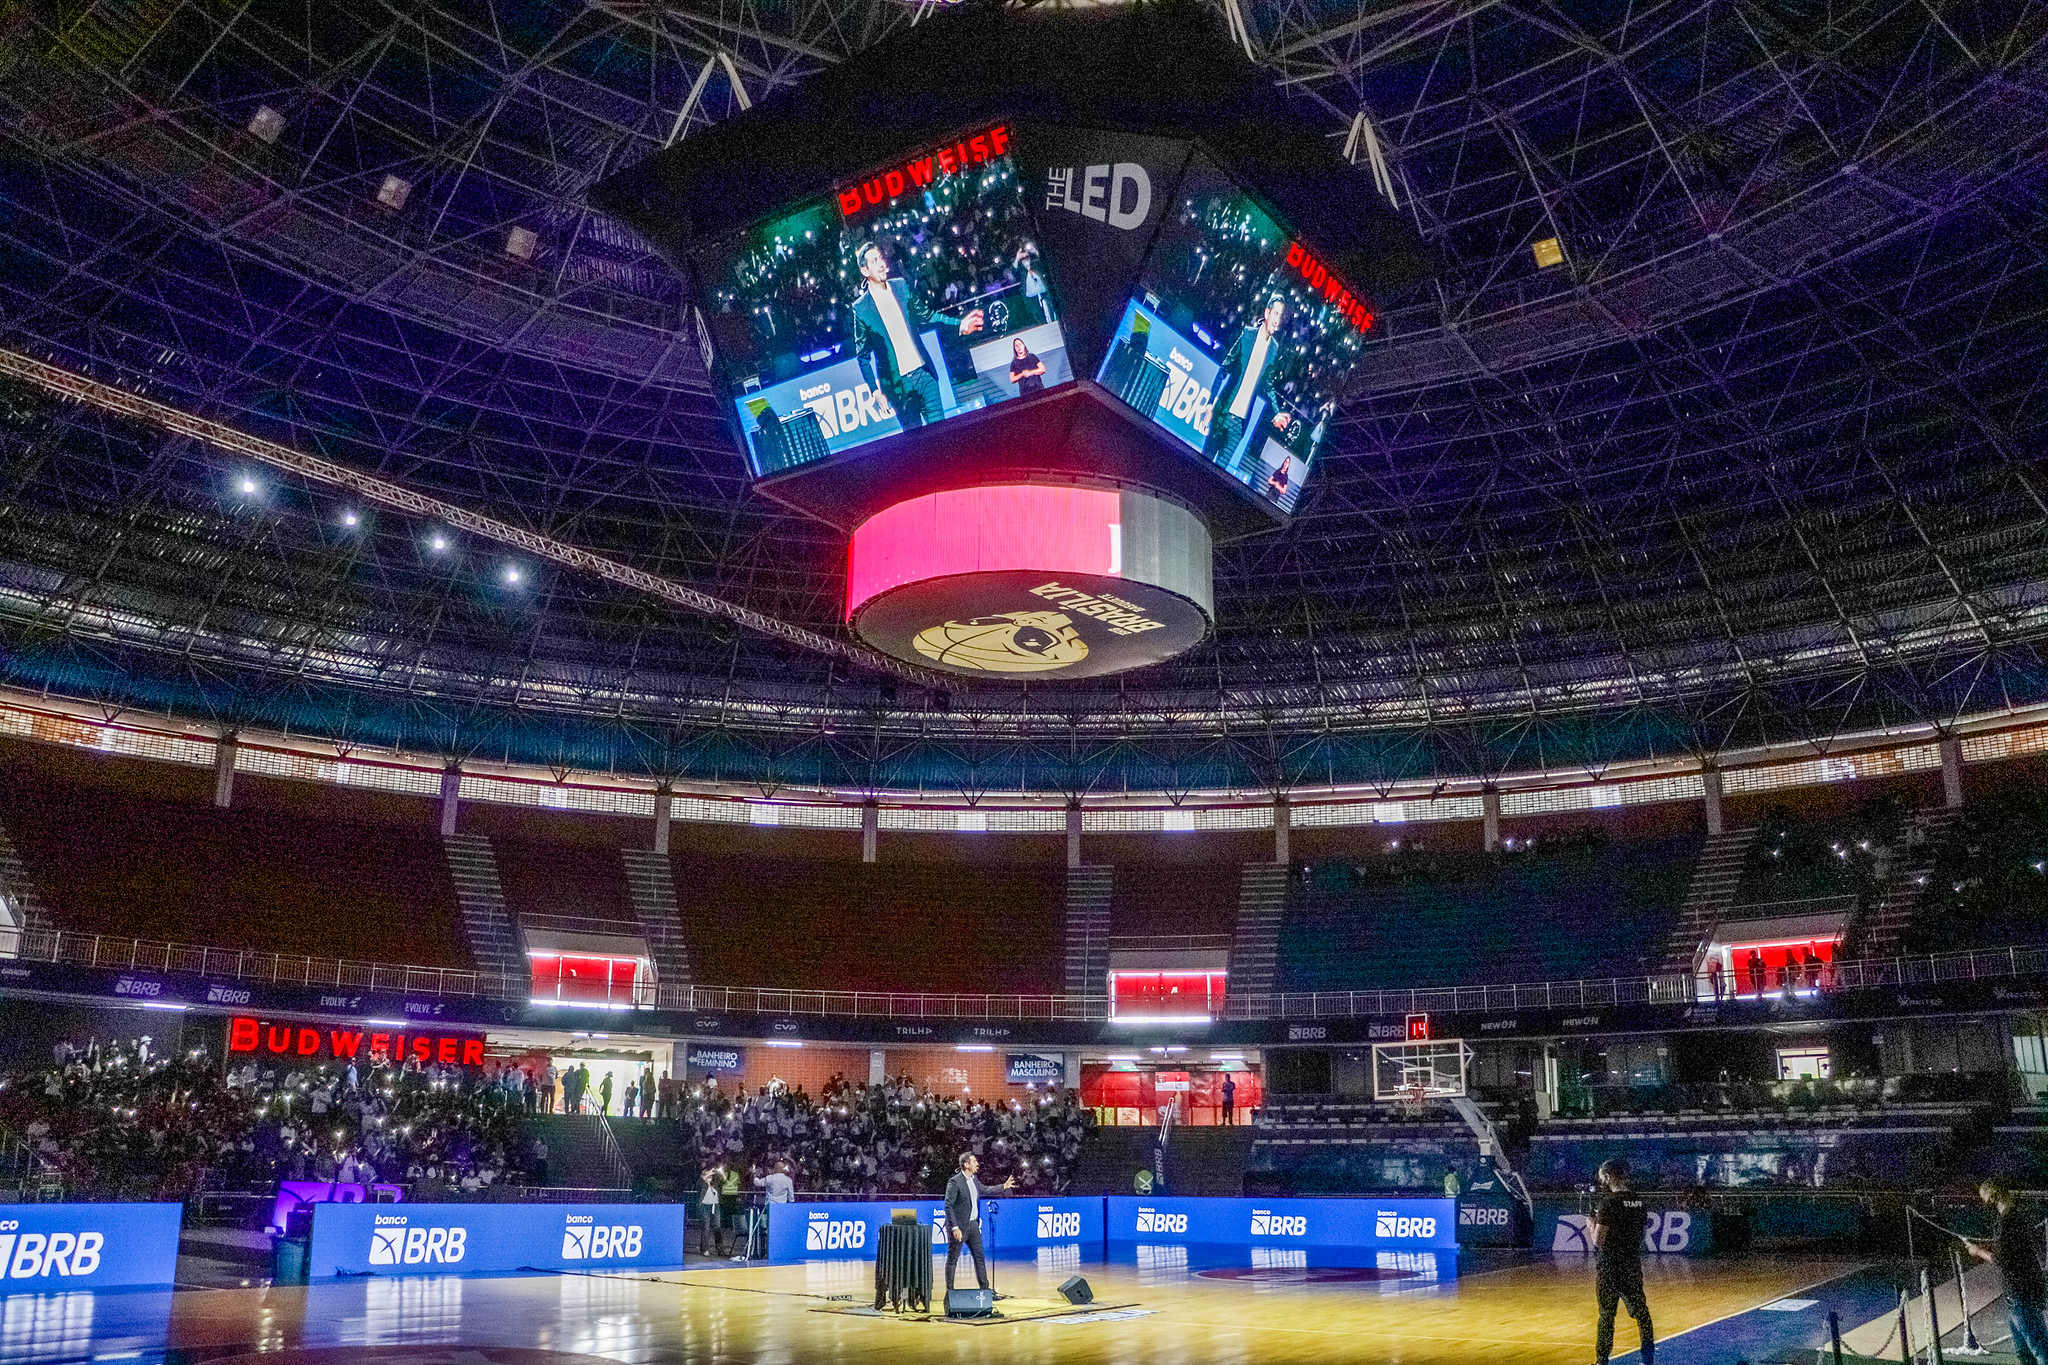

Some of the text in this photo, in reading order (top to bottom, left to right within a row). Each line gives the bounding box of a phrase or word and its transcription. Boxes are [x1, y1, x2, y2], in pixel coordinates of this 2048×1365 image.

[1046, 167, 1066, 211] THE
[1063, 162, 1152, 231] LED
[1168, 346, 1193, 372] banco
[800, 382, 831, 401] banco
[1172, 377, 1211, 437] BR
[1029, 581, 1166, 633] BRASÍLIA
[130, 982, 162, 996] BRB
[221, 988, 250, 1004] BRB
[320, 996, 347, 1008] EVOLVE
[405, 1002, 431, 1013] EVOLVE
[1302, 1027, 1327, 1039] BRB
[1381, 1025, 1406, 1038] BRB
[1412, 1023, 1427, 1036] 14
[231, 1017, 484, 1065] BUDWEISER
[697, 1050, 738, 1061] BANHEIRO
[697, 1059, 737, 1068] FEMININO
[1011, 1067, 1059, 1077] MASCULINO
[1014, 1060, 1055, 1069] BANHEIRO
[809, 1211, 829, 1220] banco
[933, 1208, 946, 1216] ban
[1038, 1205, 1054, 1213] banco
[1377, 1209, 1398, 1217] banco
[1476, 1208, 1509, 1225] BRB
[375, 1214, 407, 1225] banco
[566, 1213, 593, 1224] banco
[1053, 1212, 1081, 1237] BRB
[1154, 1213, 1188, 1233] BRB
[1269, 1216, 1307, 1236] BRB
[827, 1221, 866, 1250] BRB
[1396, 1217, 1436, 1238] BRB
[1645, 1211, 1692, 1252] RB
[404, 1227, 467, 1264] BRB
[590, 1225, 643, 1259] BRB
[10, 1231, 104, 1279] BRB
